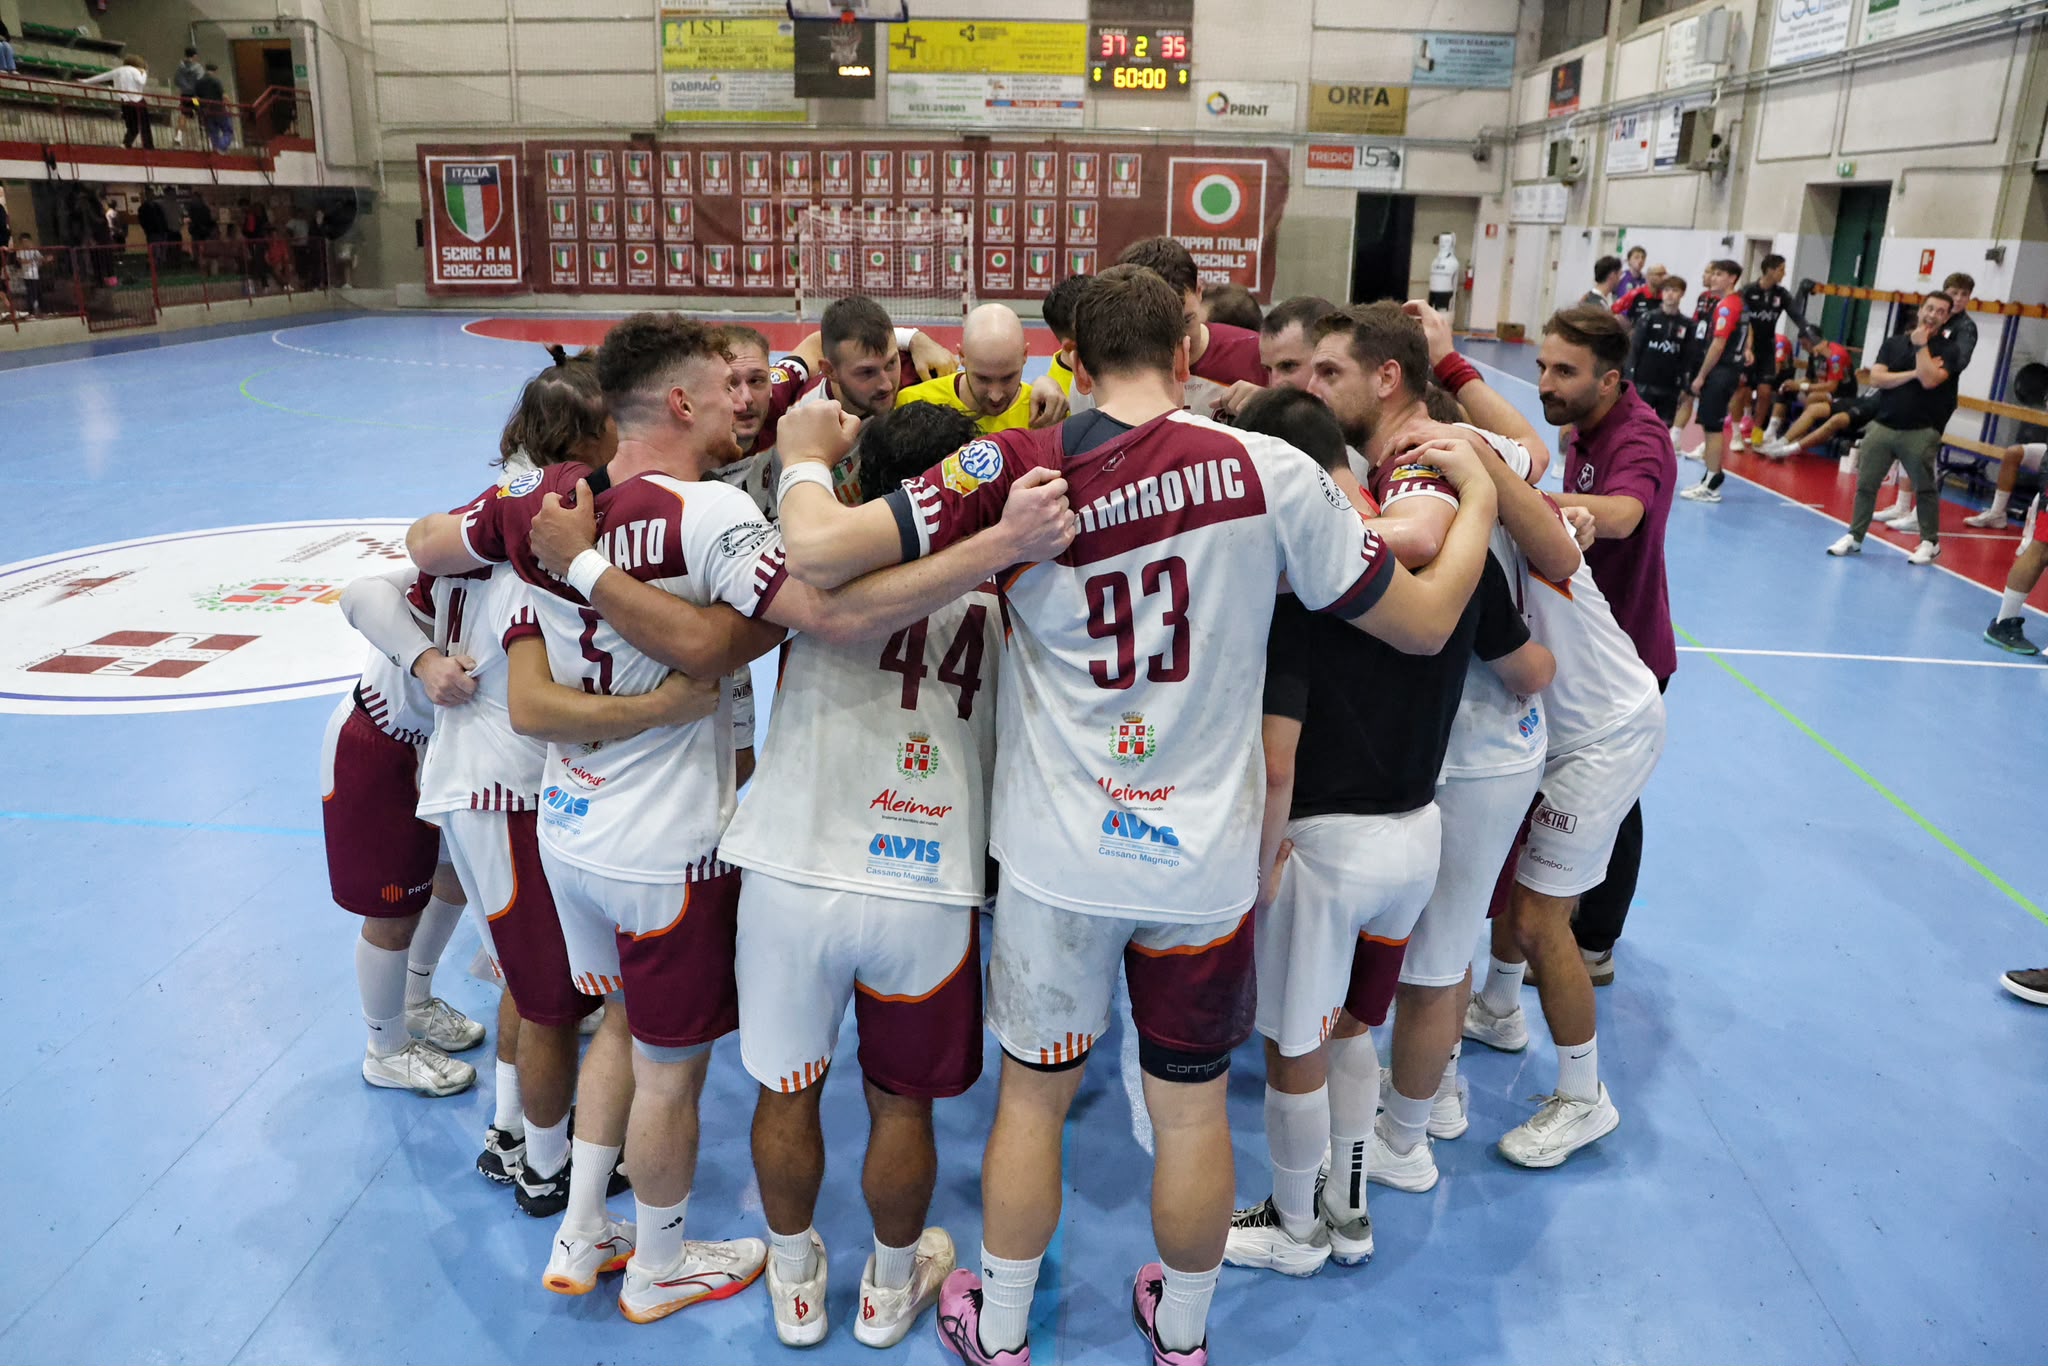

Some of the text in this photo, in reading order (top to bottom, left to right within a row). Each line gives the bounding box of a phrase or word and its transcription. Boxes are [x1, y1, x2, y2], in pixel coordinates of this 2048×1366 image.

[1102, 35, 1126, 56] 37
[1135, 36, 1148, 57] 2
[1161, 36, 1186, 58] 35
[1113, 67, 1167, 89] 60:00
[1328, 86, 1389, 106] ORFA
[1230, 104, 1268, 116] PRINT
[452, 168, 490, 178] ITALIA
[442, 247, 511, 260] SERIE A M
[1217, 237, 1258, 252] ITALIA
[1191, 253, 1247, 268] ASCHILE
[1085, 555, 1190, 690] 93
[879, 604, 987, 721] 44
[869, 788, 953, 818] Aleimar
[869, 833, 942, 864] AVIS
[1098, 846, 1181, 868] Cassano Magnago
[865, 866, 939, 884] Cassano Magnago
